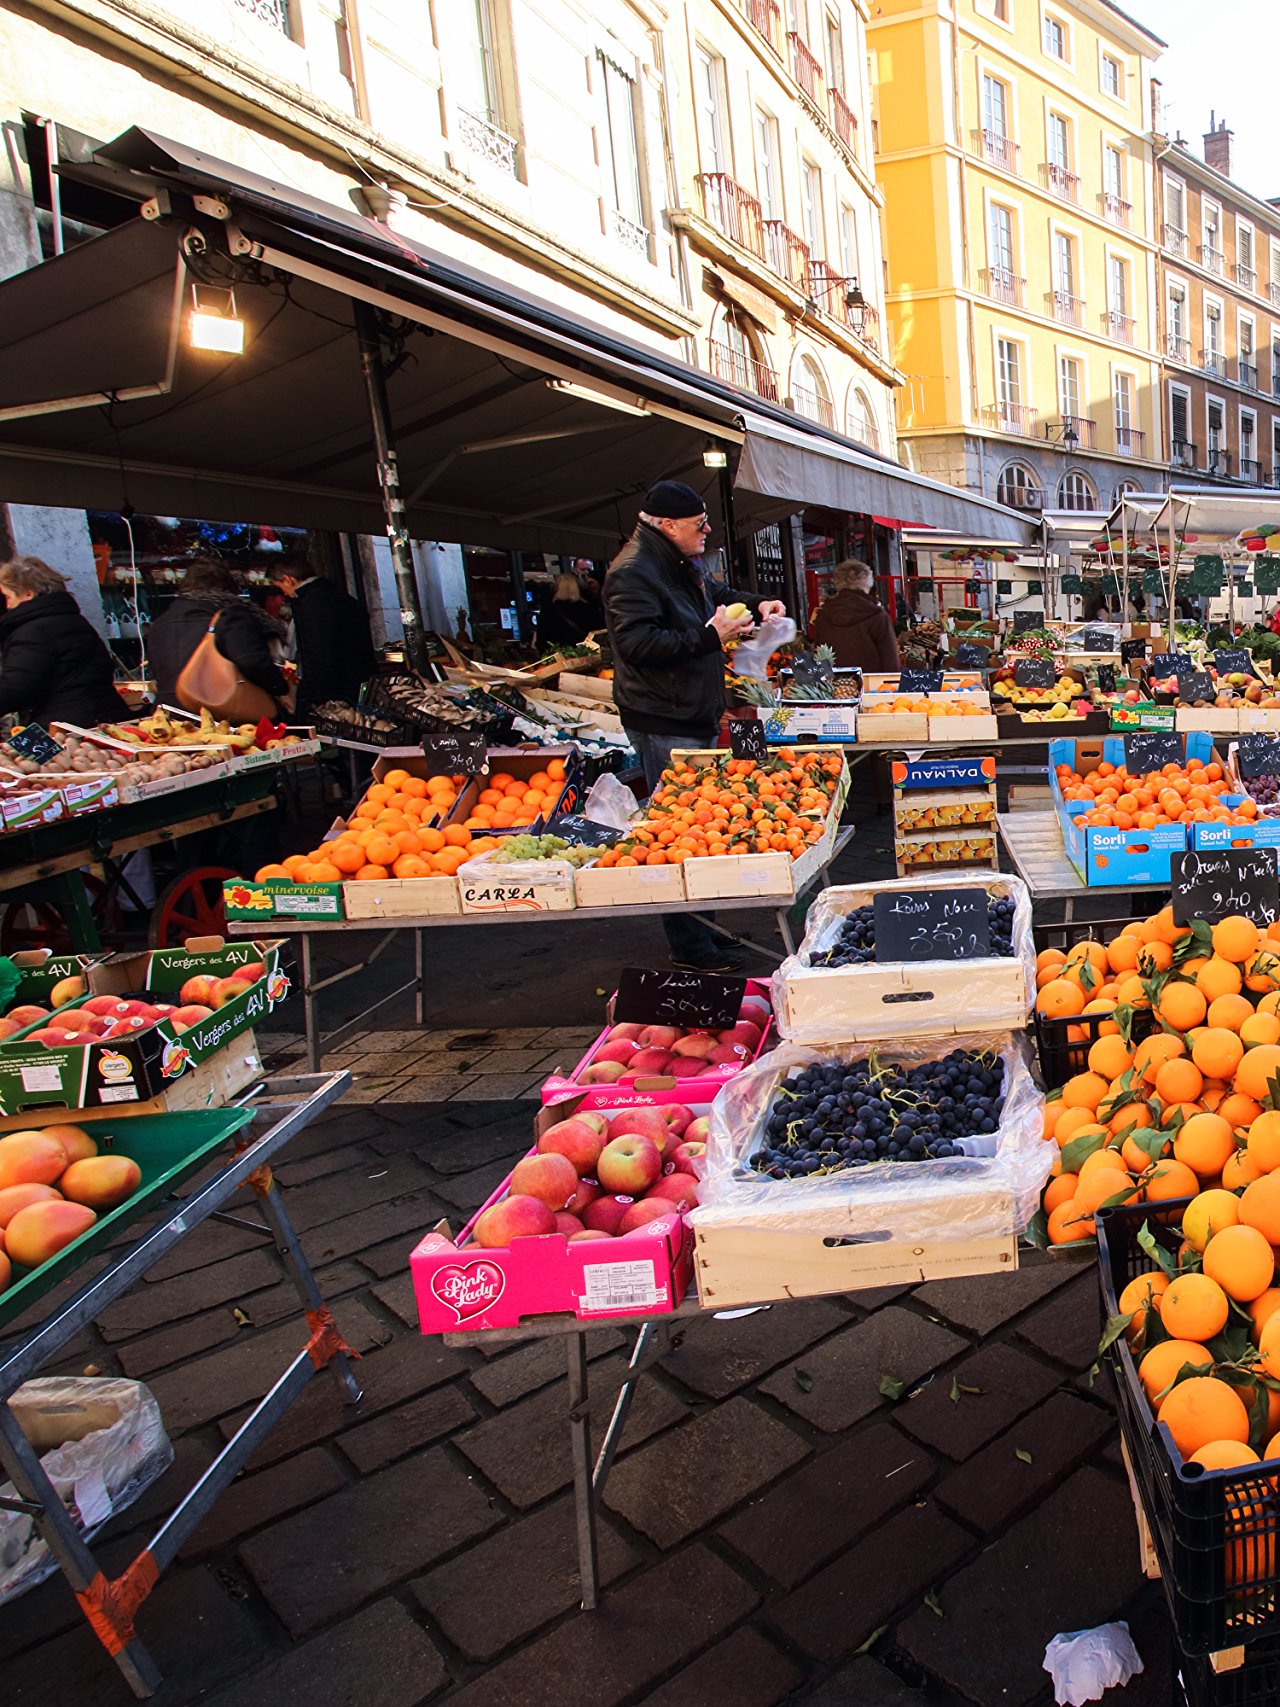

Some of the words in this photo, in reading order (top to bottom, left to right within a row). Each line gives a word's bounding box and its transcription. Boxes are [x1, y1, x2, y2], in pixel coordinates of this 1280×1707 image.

[245, 753, 272, 765] Sistema
[282, 746, 306, 757] Frutta
[911, 768, 978, 780] DALMAU
[1093, 834, 1126, 845] Sorli
[1199, 829, 1231, 841] Sorli
[263, 885, 330, 897] minervoise
[465, 887, 536, 902] CARLA
[161, 956, 207, 971] Vergers
[209, 955, 222, 964] des
[225, 950, 249, 965] 4V
[31, 969, 45, 978] des
[48, 963, 72, 978] 4V
[192, 1019, 233, 1051] Vergers
[233, 1012, 245, 1026] des
[246, 988, 265, 1018] 4V
[614, 1097, 633, 1105] Pink
[634, 1096, 656, 1104] Lady
[444, 1271, 488, 1298] Pink
[454, 1283, 497, 1308] Lady
